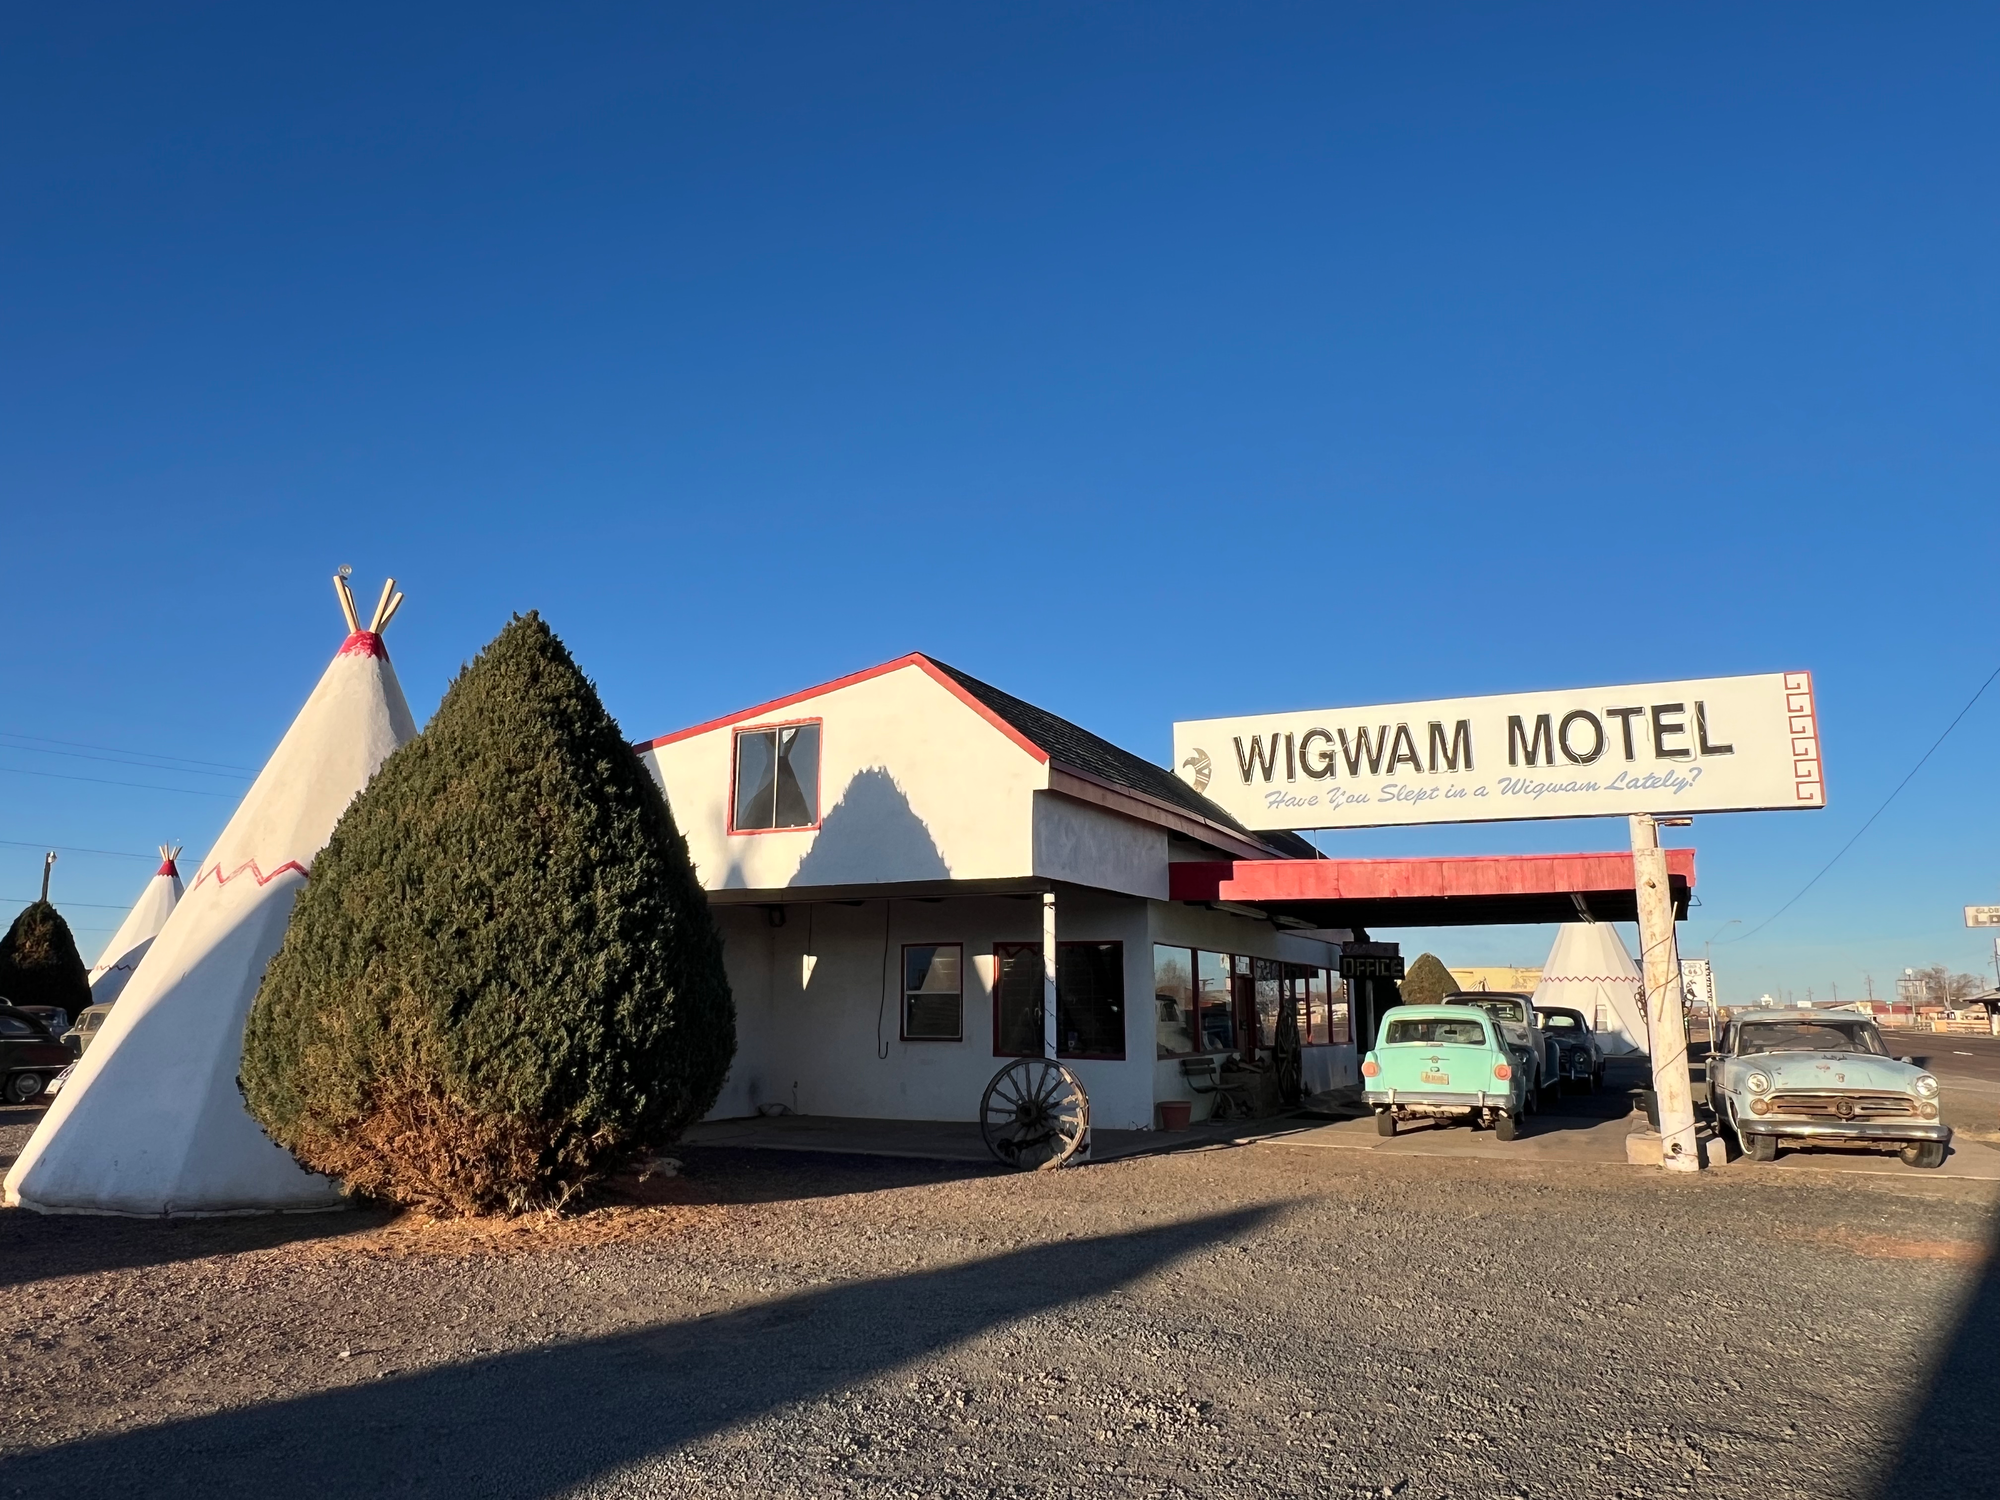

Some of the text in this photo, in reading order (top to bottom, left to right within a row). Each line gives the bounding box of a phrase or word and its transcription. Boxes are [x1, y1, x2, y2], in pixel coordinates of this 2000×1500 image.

[1232, 701, 1734, 785] WIGWAM MOTEL
[1264, 767, 1702, 811] Have You Slept in a Wigwam Lately?
[1343, 958, 1402, 976] OFFICE
